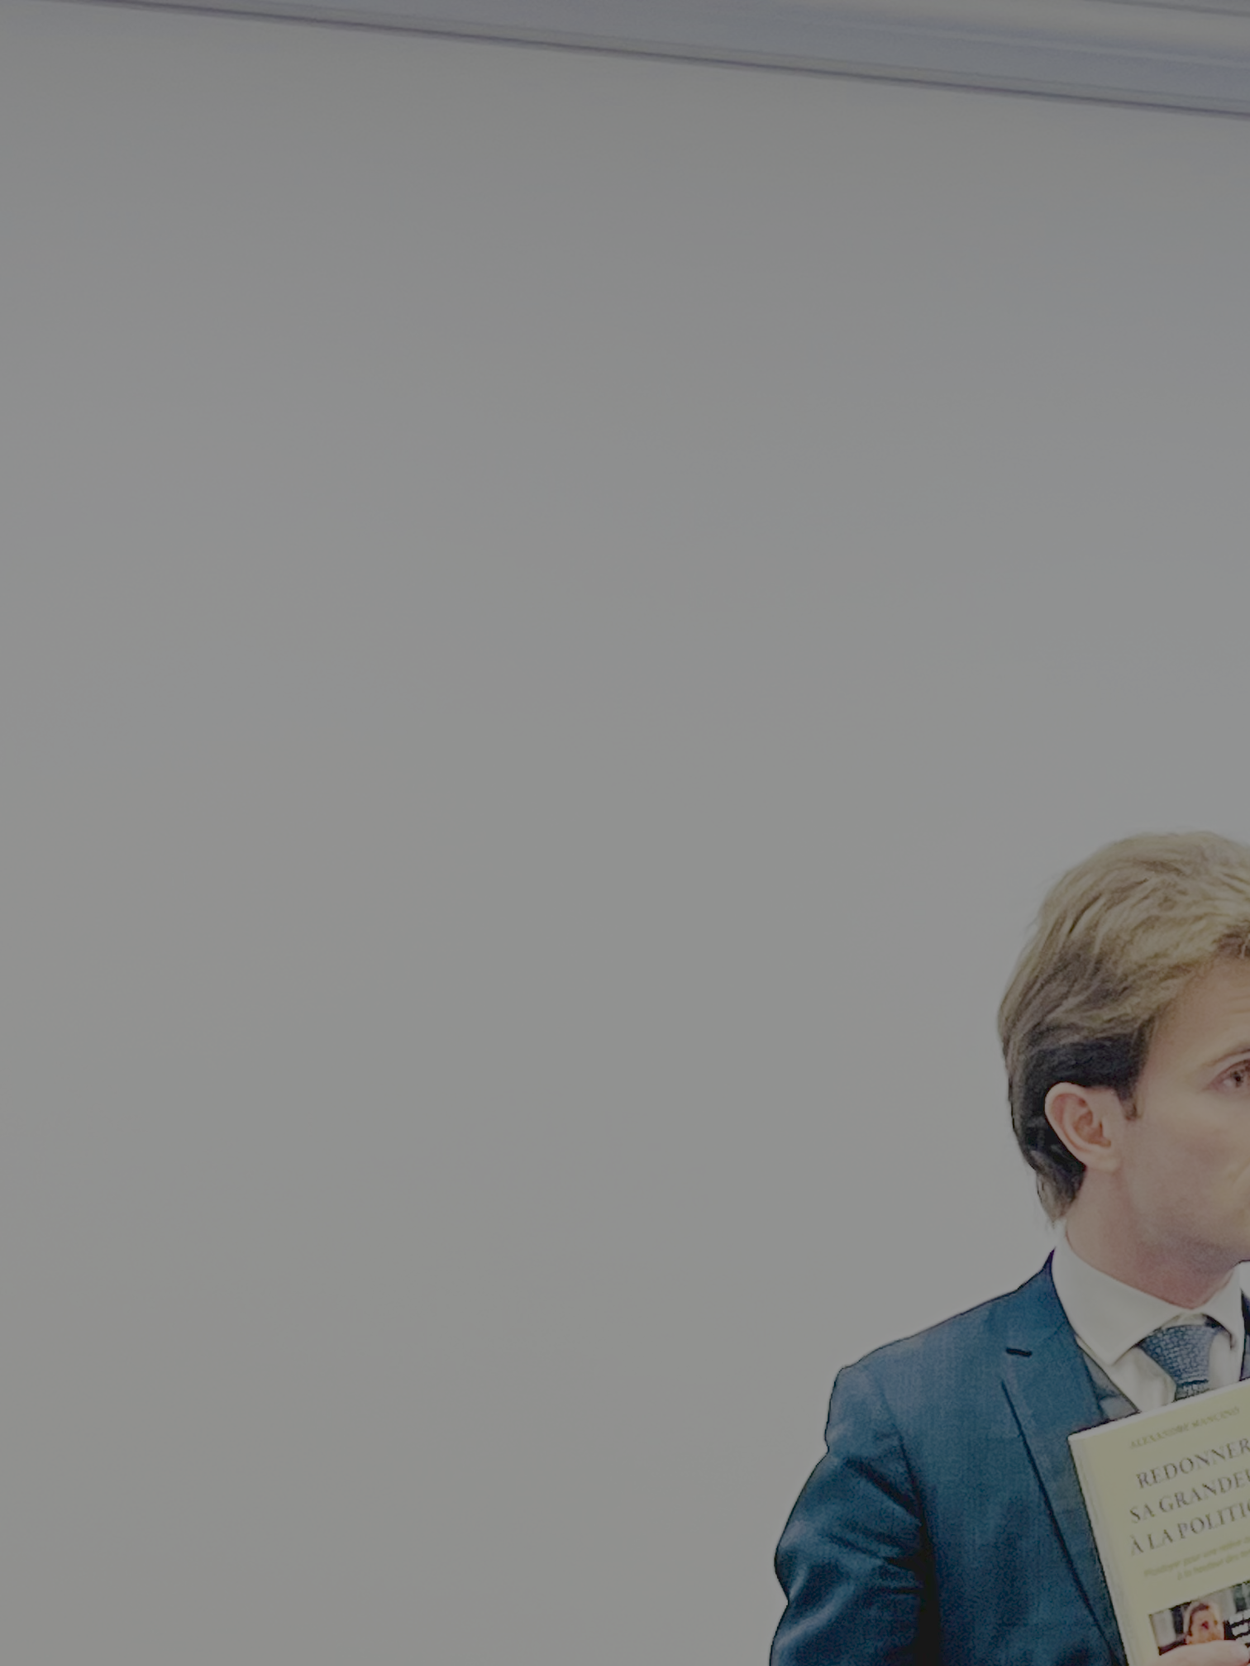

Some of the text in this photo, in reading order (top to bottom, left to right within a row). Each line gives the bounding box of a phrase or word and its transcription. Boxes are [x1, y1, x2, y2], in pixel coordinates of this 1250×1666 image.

[1129, 1503, 1155, 1524] SA
[1130, 1535, 1144, 1556] À
[1147, 1529, 1174, 1550] LA
